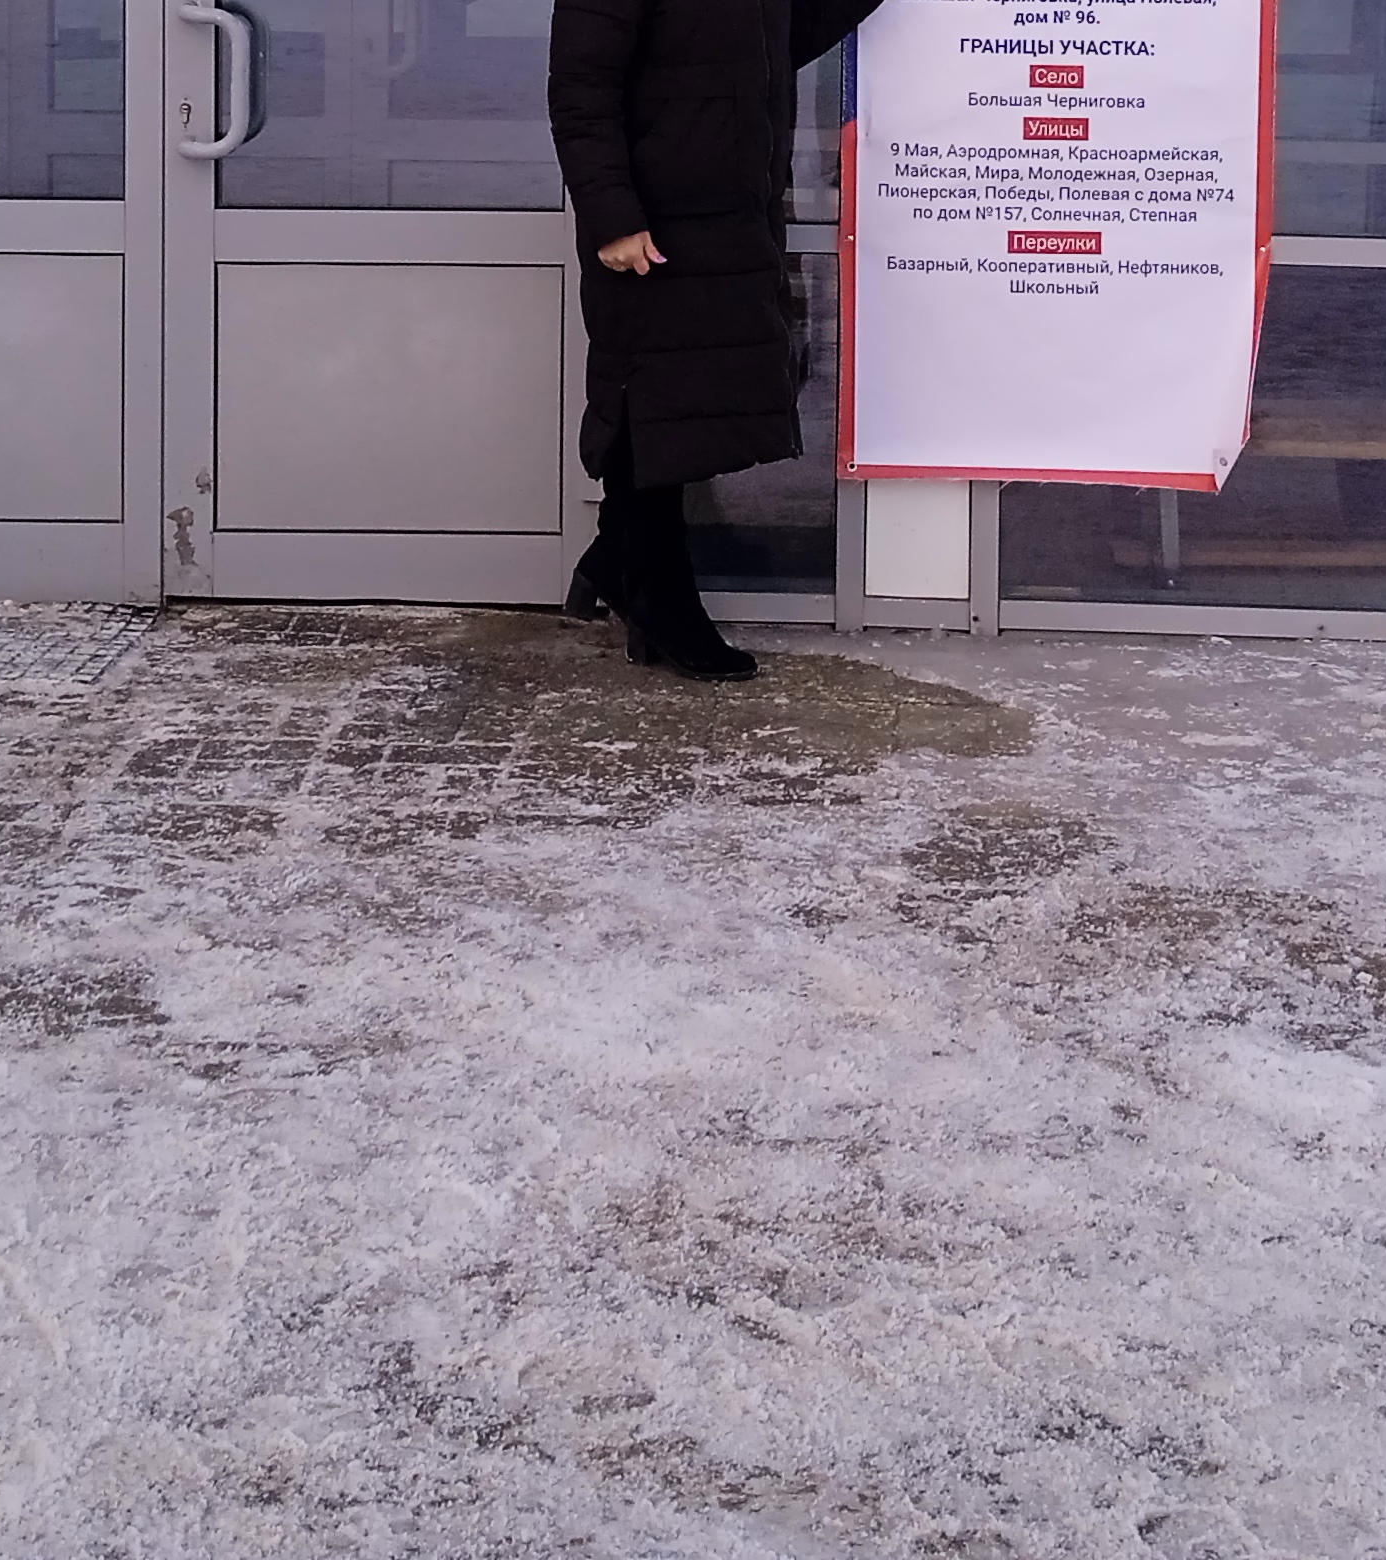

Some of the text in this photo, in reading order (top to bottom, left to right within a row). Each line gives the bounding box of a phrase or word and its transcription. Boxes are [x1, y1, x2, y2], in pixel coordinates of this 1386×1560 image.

[1014, 10, 1100, 26] дом № 96.
[961, 38, 1155, 57] ГРАНИЦЫ УЧАСТКА:
[1035, 68, 1078, 85] Село
[969, 92, 1145, 110] Большая Черниговка
[1029, 120, 1083, 138] Улицы
[891, 143, 1223, 164] 9 Мая, Аэродромная, Красноармейская,
[895, 163, 1218, 184] Майская, Мира, Молодежная, Озерная,
[879, 184, 1234, 203] Пионерская, Победы, Полевая с дома №74
[913, 206, 1197, 223] по дом №157, Солнечная, Степная
[1014, 234, 1096, 252] Переулки
[887, 256, 1223, 277] Базарный, Кооперативный, Нефтяников,
[1011, 280, 1099, 294] Школьный
